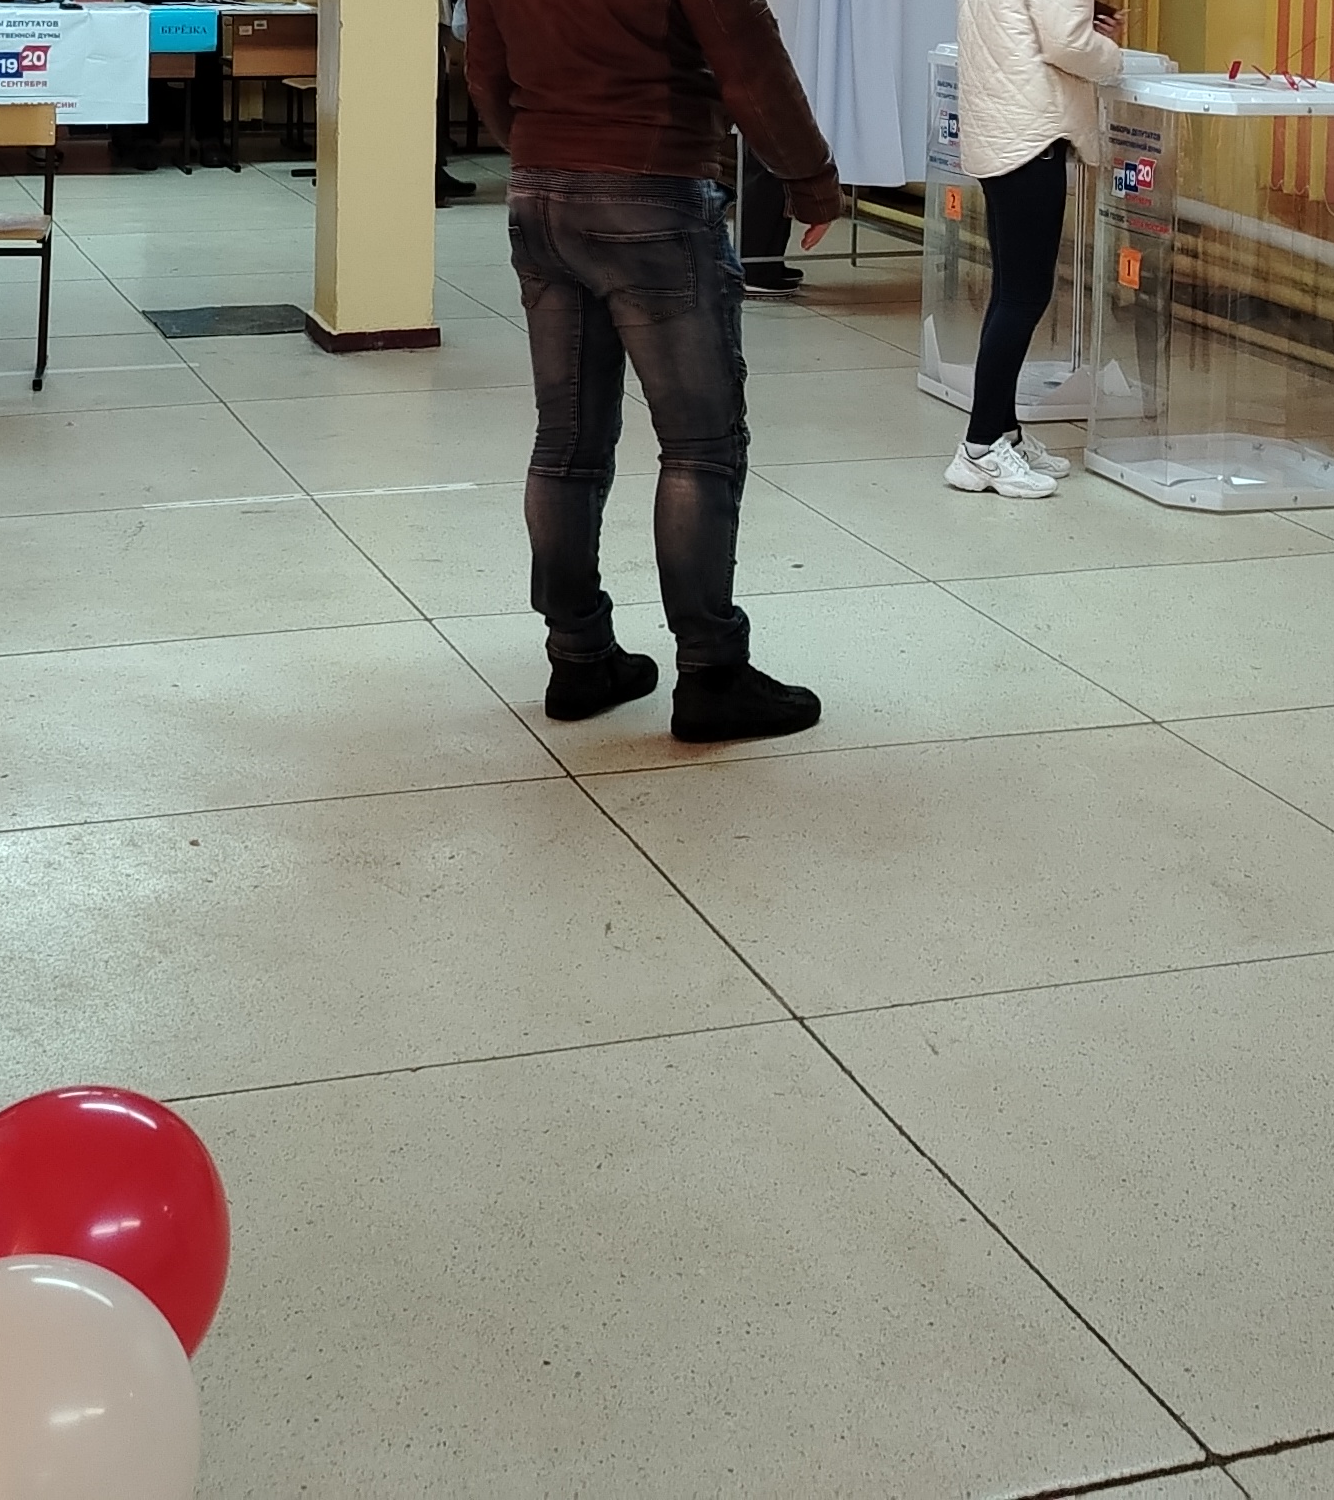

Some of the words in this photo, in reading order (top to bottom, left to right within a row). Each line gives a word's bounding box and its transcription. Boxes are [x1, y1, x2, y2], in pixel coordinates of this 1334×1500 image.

[6, 20, 59, 28] ДЕПУТАТОВ
[160, 24, 207, 36] БЕРЁЗКА
[0, 59, 18, 74] 19
[22, 51, 45, 66] 20
[1114, 176, 1124, 192] 18
[1126, 170, 1136, 186] 19
[1138, 165, 1152, 181] 20
[951, 193, 956, 208] 2
[1127, 259, 1131, 276] 1
